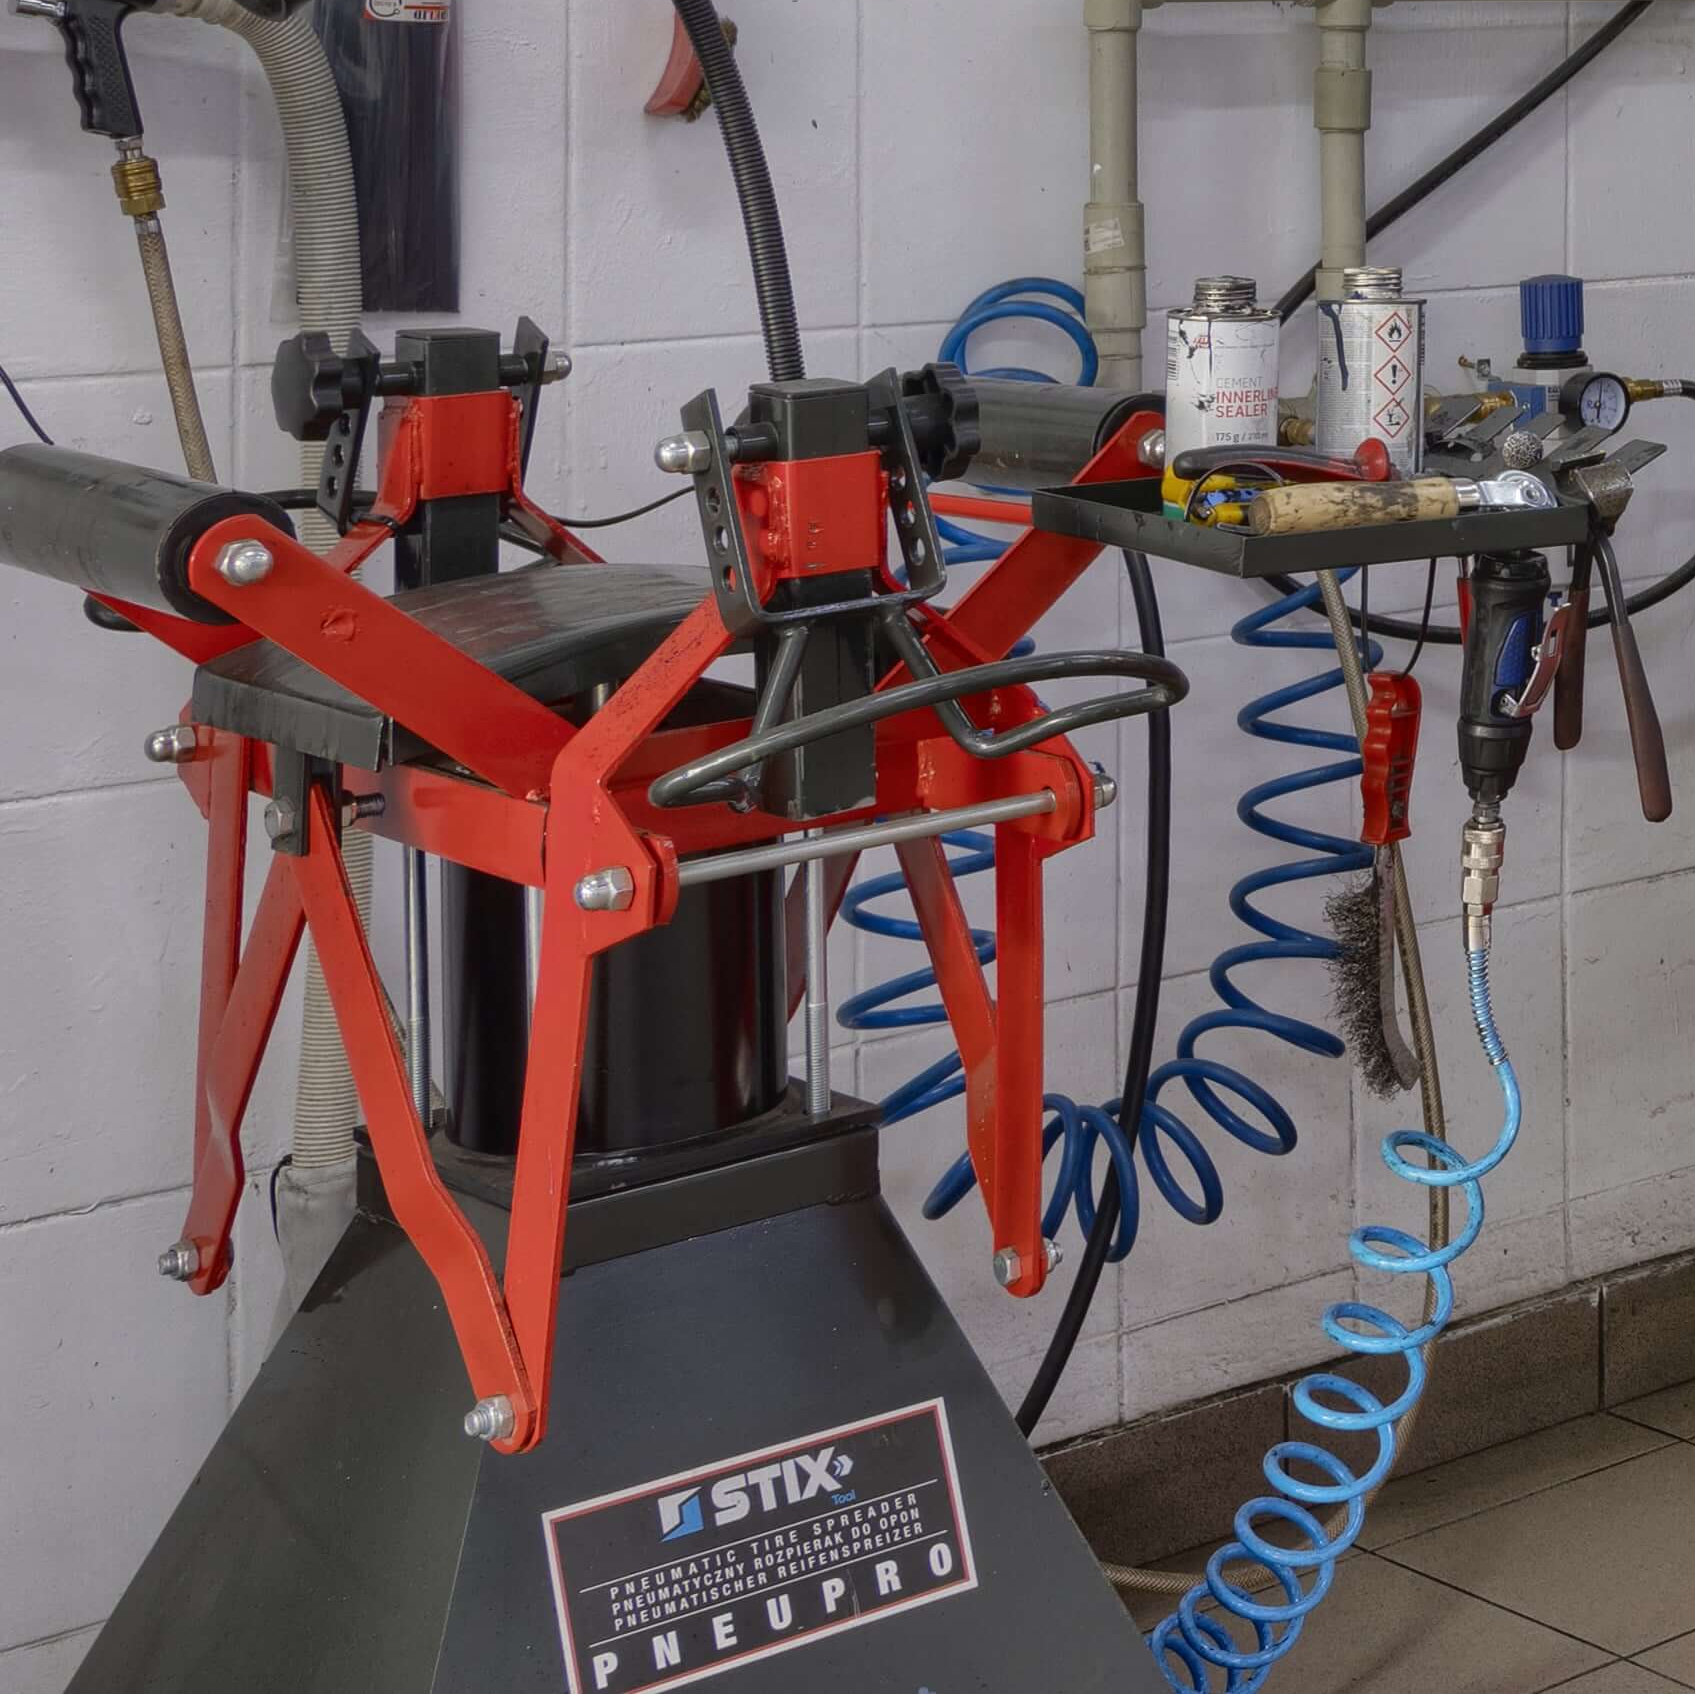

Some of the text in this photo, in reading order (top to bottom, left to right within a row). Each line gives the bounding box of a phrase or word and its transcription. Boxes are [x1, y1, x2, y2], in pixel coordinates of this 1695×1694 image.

[1216, 376, 1263, 388] CEMENT
[1216, 403, 1268, 418] SEALER
[711, 1446, 842, 1527] STIX
[831, 1489, 856, 1505] Tool
[610, 1493, 917, 1601] PNEUMATIC TIRE SPREADER
[612, 1508, 920, 1616] PNEUMATYCZNY ROZPIERAK DO OPON
[614, 1522, 923, 1632] PNEUMATISCHER REIFENSPREIZER
